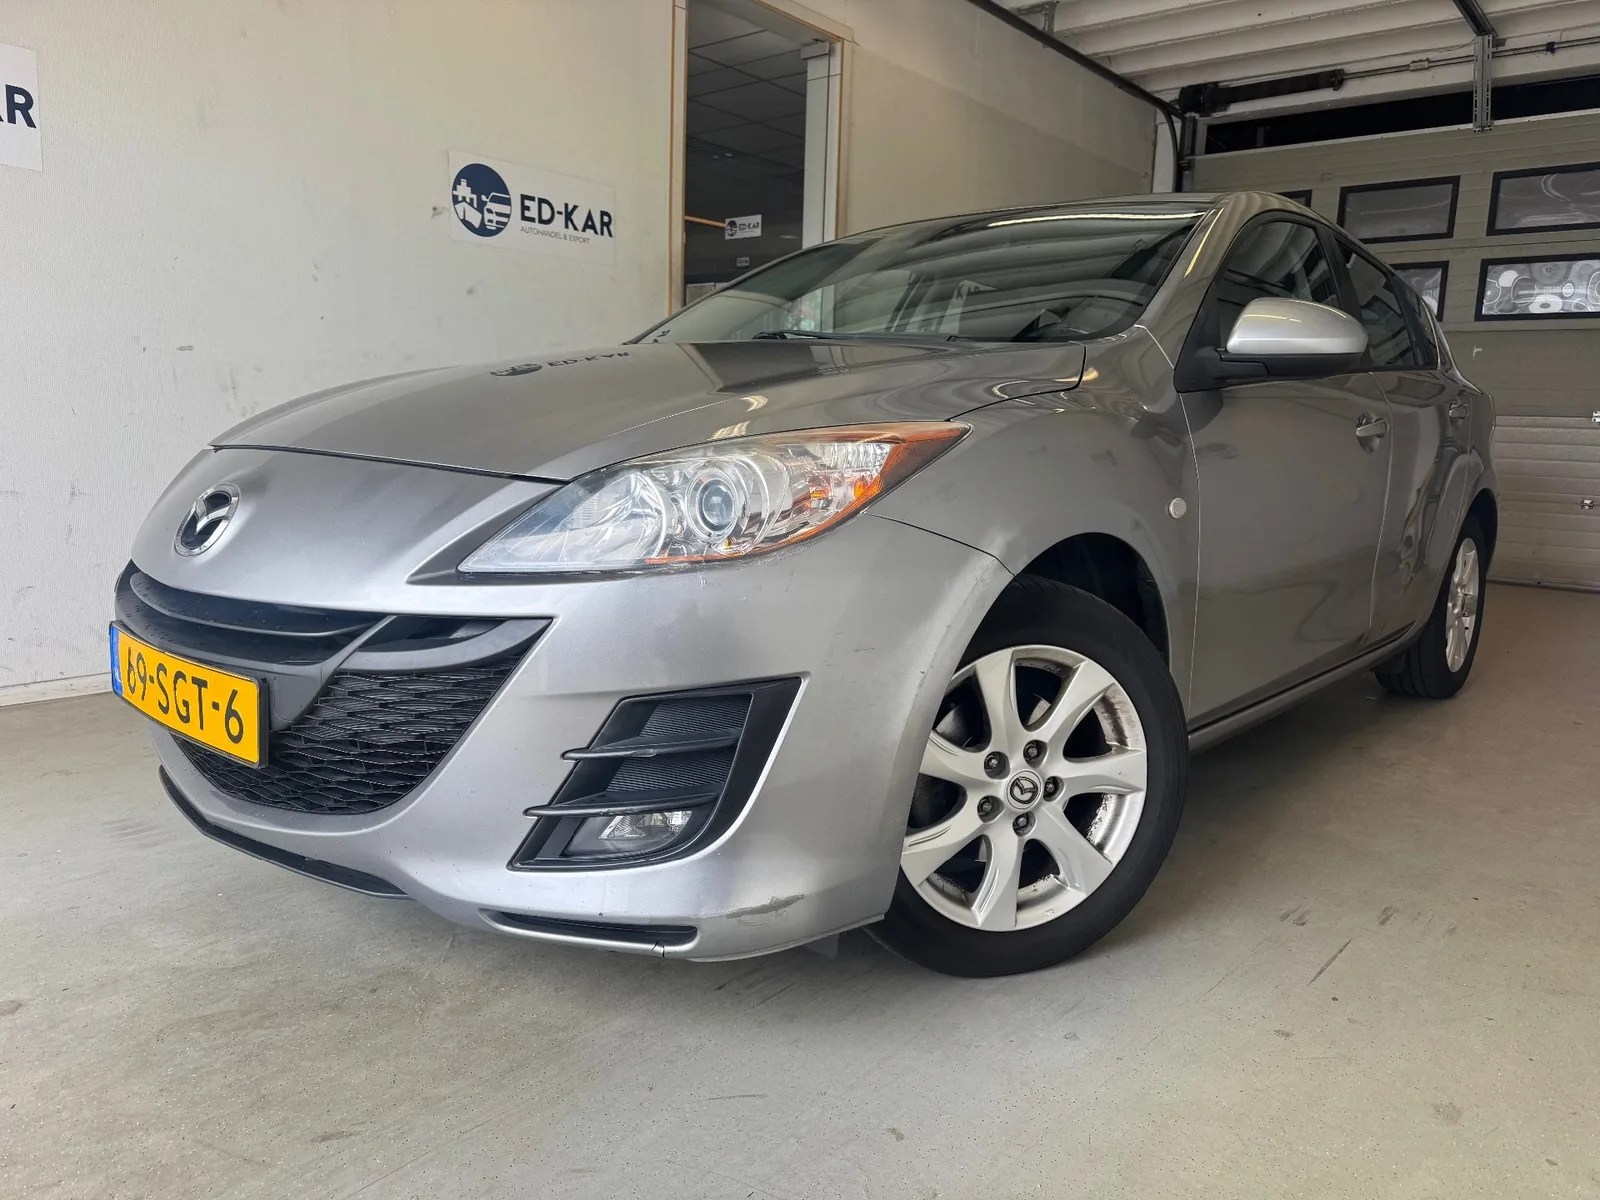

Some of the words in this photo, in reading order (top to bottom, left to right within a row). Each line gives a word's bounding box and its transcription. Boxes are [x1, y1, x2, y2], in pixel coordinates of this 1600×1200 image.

[0, 83, 37, 129] R
[520, 193, 613, 238] ED-KAR
[520, 226, 562, 240] AUTOHANDEL
[569, 234, 590, 244] EXPORT
[739, 221, 760, 231] ED-KAR
[127, 646, 244, 744] 69-SGT-6
